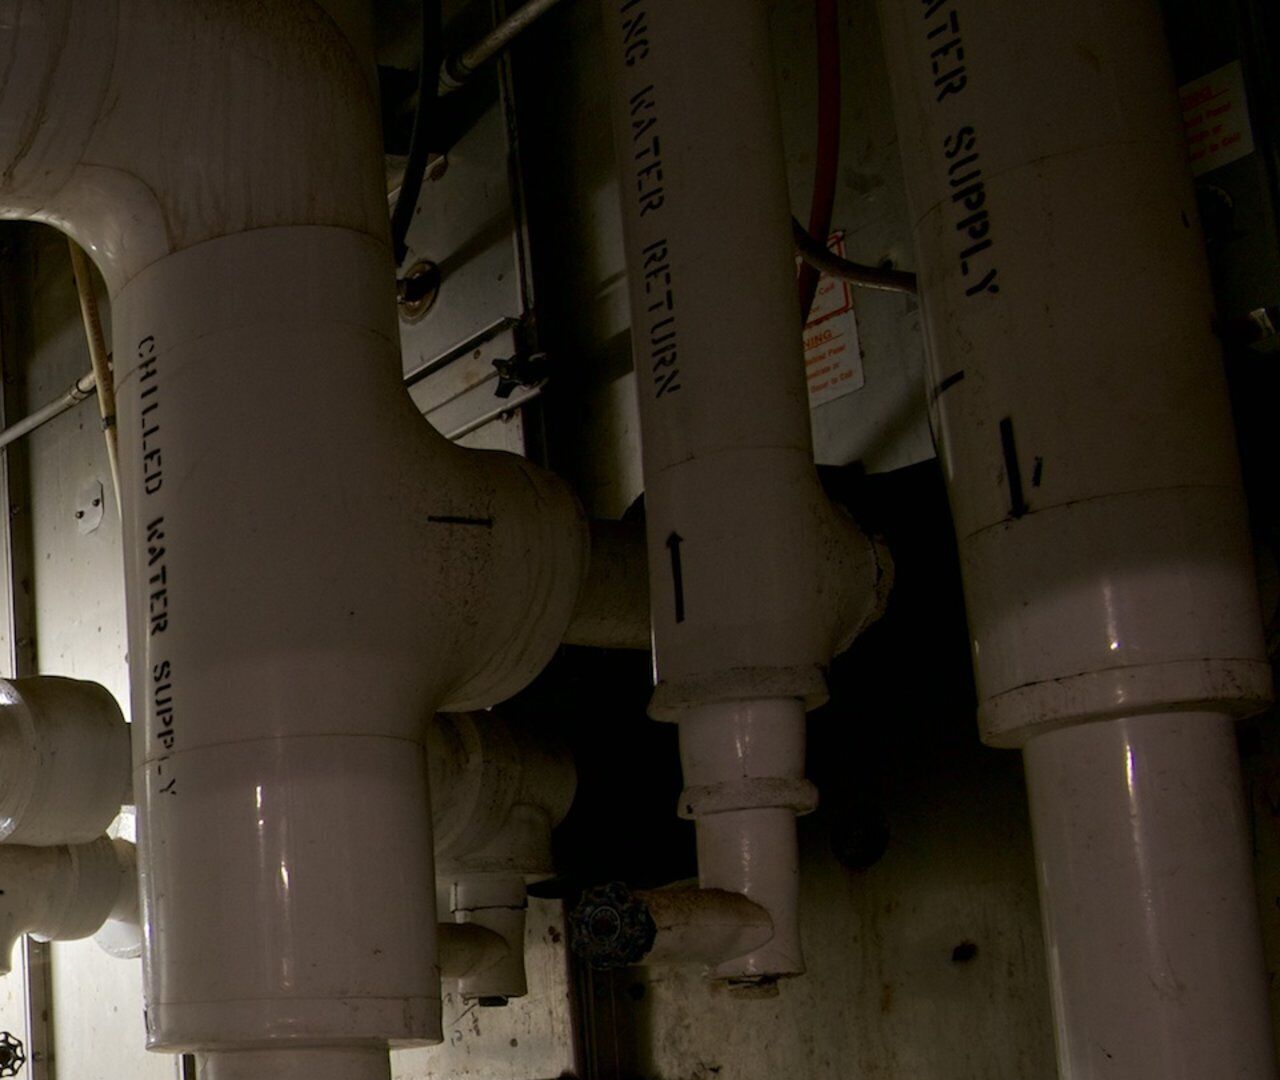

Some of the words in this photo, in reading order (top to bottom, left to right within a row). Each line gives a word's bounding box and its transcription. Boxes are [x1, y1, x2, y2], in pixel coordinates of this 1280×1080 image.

[630, 85, 664, 217] WATER
[944, 126, 999, 296] SUPPLY
[642, 239, 681, 398] RETURN
[139, 335, 163, 495] CHILLED
[147, 517, 168, 636] WATER
[153, 660, 177, 795] SUPPLY
